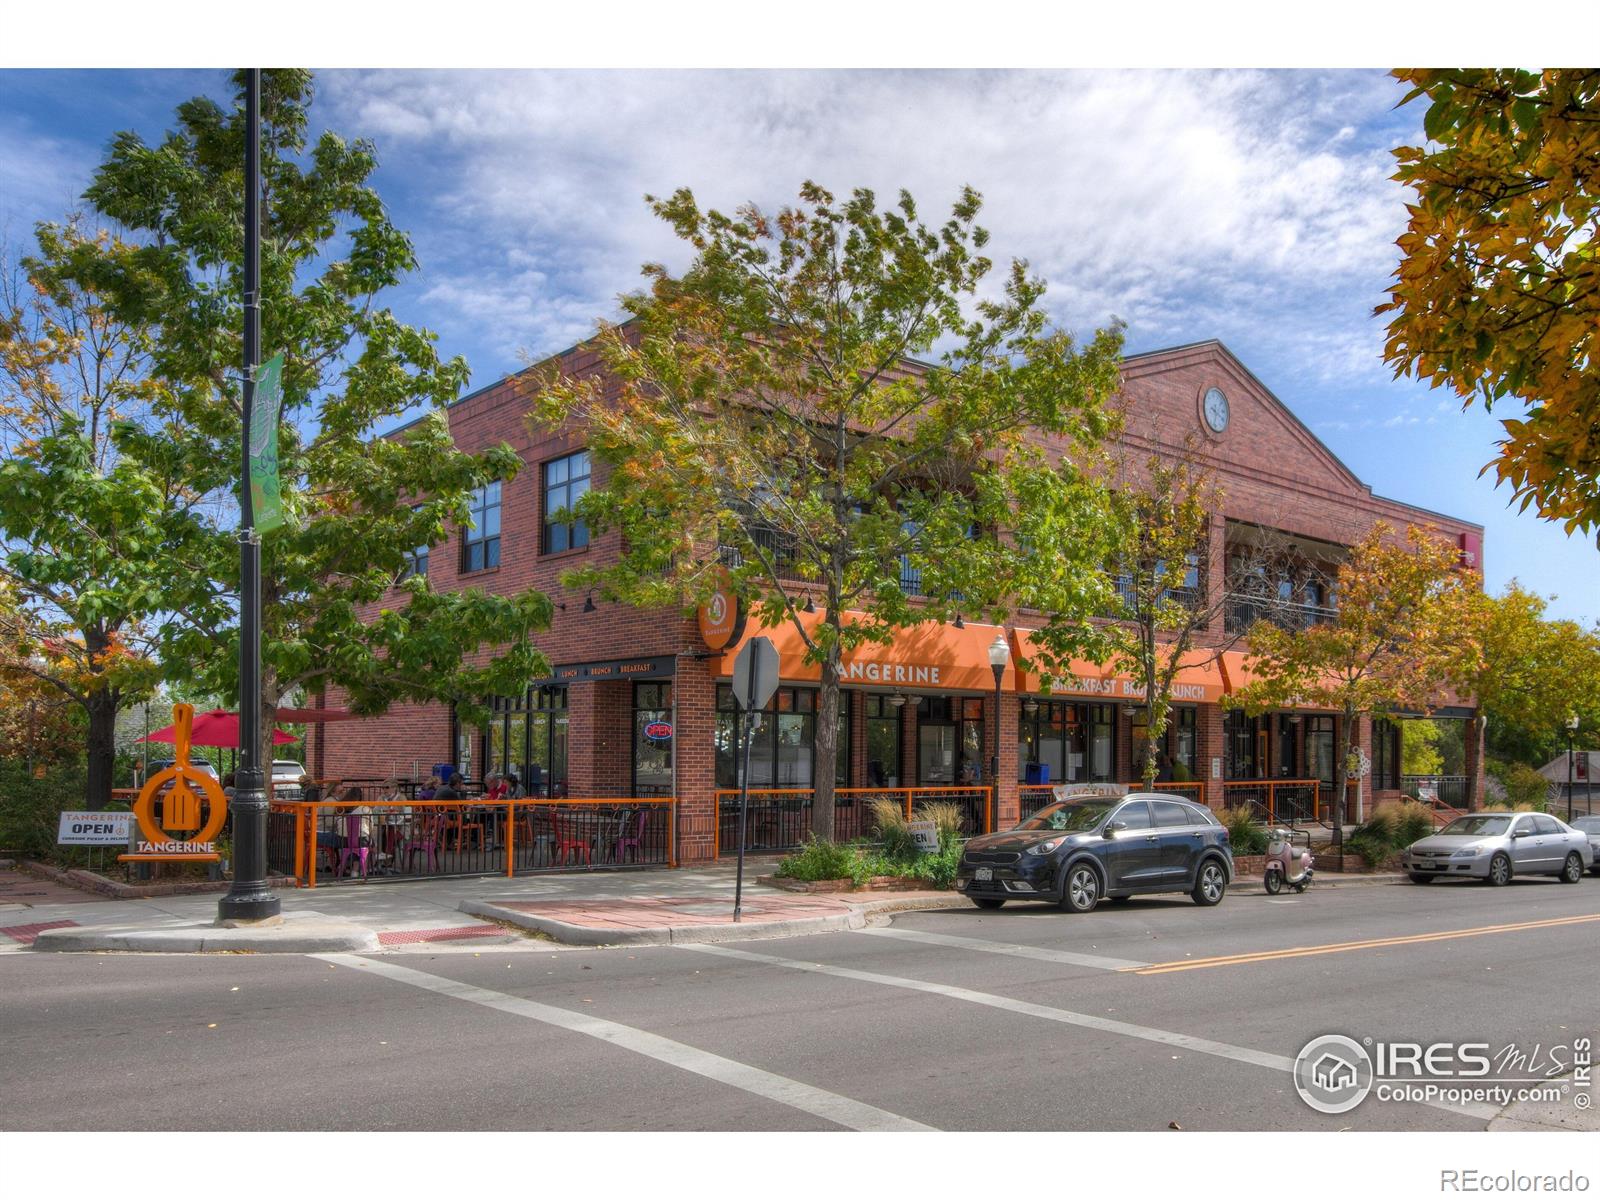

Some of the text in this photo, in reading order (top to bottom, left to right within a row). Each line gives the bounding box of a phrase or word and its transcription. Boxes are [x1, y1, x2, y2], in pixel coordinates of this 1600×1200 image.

[561, 669, 578, 678] LUNCH
[591, 666, 612, 676] BRUNCH
[619, 663, 651, 673] BREAKFAST
[834, 661, 940, 684] ANGERINE
[647, 725, 672, 736] OPEN
[72, 823, 114, 834] OPEN
[137, 841, 216, 853] TANGERINE
